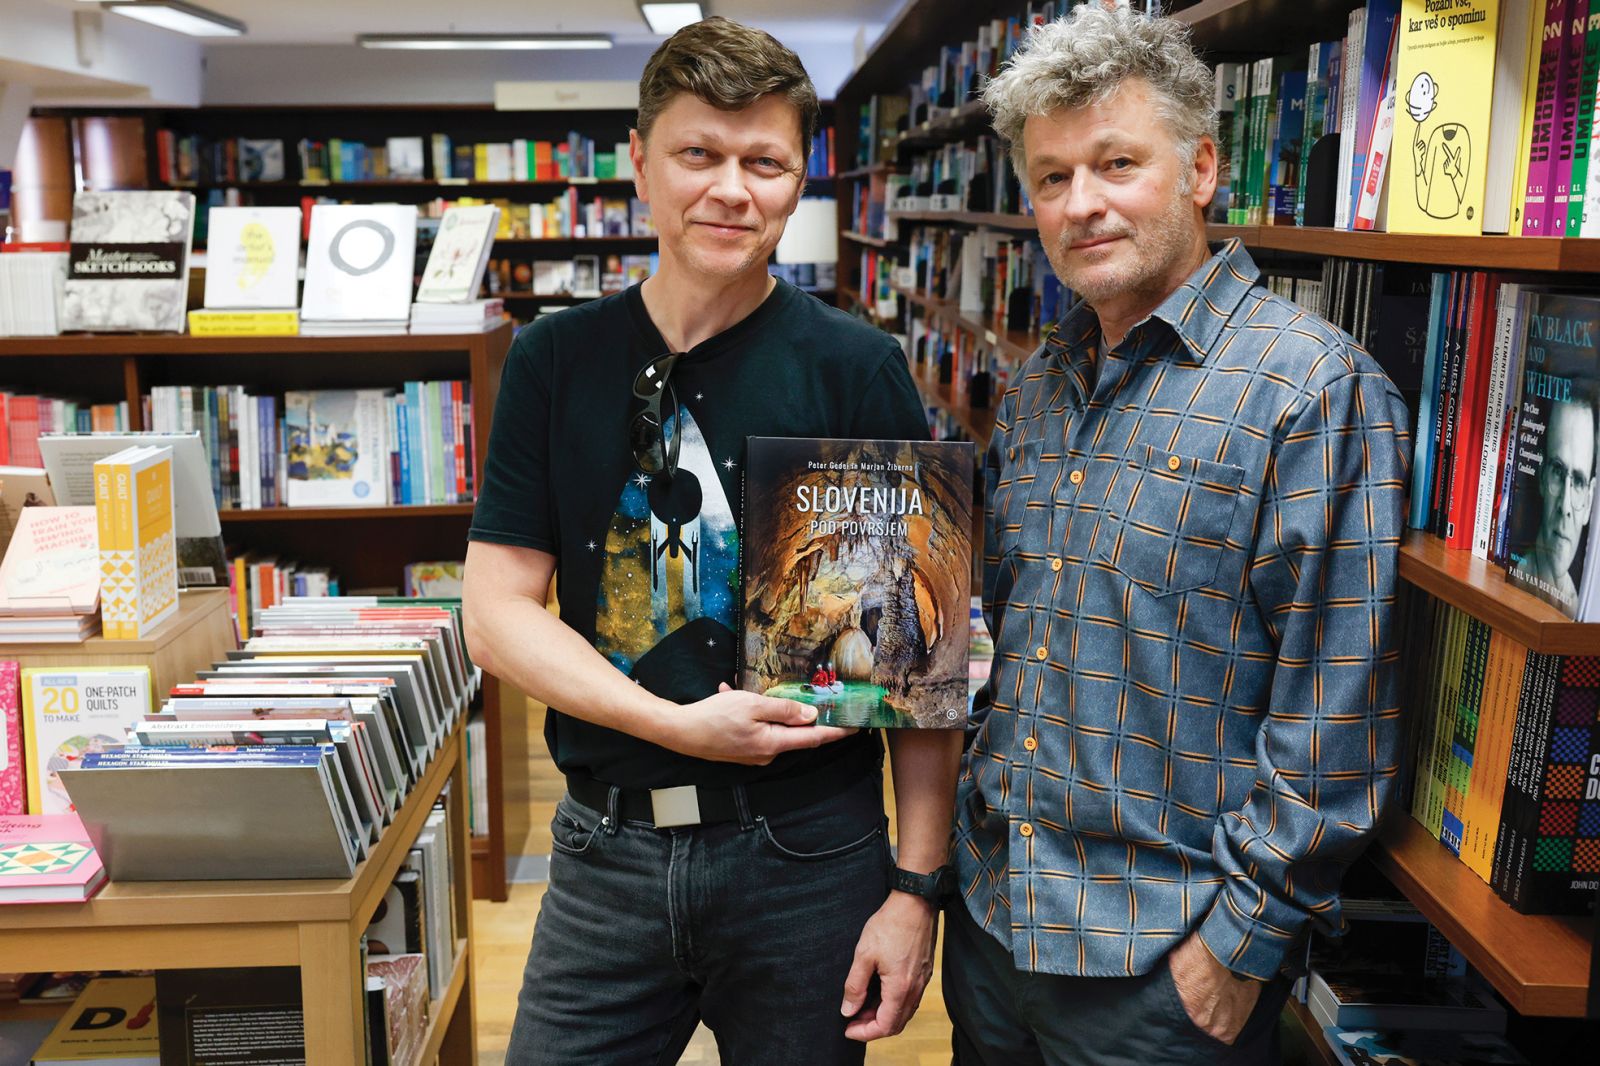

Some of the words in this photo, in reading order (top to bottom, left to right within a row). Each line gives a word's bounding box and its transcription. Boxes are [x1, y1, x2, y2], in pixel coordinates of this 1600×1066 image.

[1425, 0, 1452, 12] Pozabi
[1408, 18, 1422, 32] kar
[1424, 14, 1438, 30] veš
[1440, 19, 1446, 28] o
[1447, 8, 1486, 30] spominu
[1538, 48, 1559, 162] UMORKE
[1559, 45, 1581, 160] UMORKE
[1574, 41, 1597, 158] UMORKE
[74, 260, 176, 273] SKETCHBOOKS
[1444, 340, 1450, 349] A
[1530, 314, 1544, 342] IN
[1546, 316, 1592, 348] BLACK
[1455, 342, 1460, 350] A
[1500, 336, 1509, 378] ELEMENTS
[1527, 346, 1546, 365] AND
[1440, 352, 1448, 390] CHESS
[1451, 354, 1460, 394] CHESS
[1489, 346, 1500, 404] MASTERING
[1499, 380, 1504, 390] OF
[1526, 370, 1573, 404] WHITE
[1435, 394, 1444, 442] COURSE
[1445, 397, 1455, 446] COURSE
[1485, 406, 1493, 442] CHESS
[1492, 421, 1500, 453] TACTICS
[1507, 434, 1515, 460] Solid
[808, 461, 827, 469] Peter
[860, 463, 885, 471] Marjan
[886, 461, 913, 471] Žiberna
[1503, 464, 1511, 494] Chess
[98, 474, 109, 500] QUILT
[117, 474, 128, 500] QUILT
[796, 486, 923, 515] SLOVENIJA
[30, 516, 60, 528] HOW
[64, 512, 80, 520] TO
[32, 522, 70, 536] TRAIN
[71, 516, 96, 528] YOU
[810, 520, 836, 535] POD
[841, 518, 908, 537] POVRŠJEM
[33, 528, 85, 544] SEWING
[34, 534, 94, 553] MACHINE
[1508, 566, 1524, 580] PAUL
[1526, 573, 1538, 586] VAN
[1540, 580, 1550, 593] DER
[1470, 637, 1480, 675] CHESS
[1477, 641, 1487, 679] CHESS
[85, 686, 136, 697] ONE-PATCH
[1536, 672, 1544, 696] CHESS
[1548, 679, 1556, 703] CHESS
[42, 687, 80, 714] 20
[86, 699, 119, 711] QUILTS
[1520, 691, 1529, 725] COACHES
[44, 714, 54, 722] TO
[56, 714, 80, 722] MAKE
[1530, 697, 1540, 732] COACHES
[1541, 704, 1551, 739] COACHES
[1522, 716, 1532, 750] VICTORIA
[1534, 723, 1543, 757] VICTORIA
[1538, 740, 1546, 765] DON'T
[1570, 881, 1587, 889] JOHN
